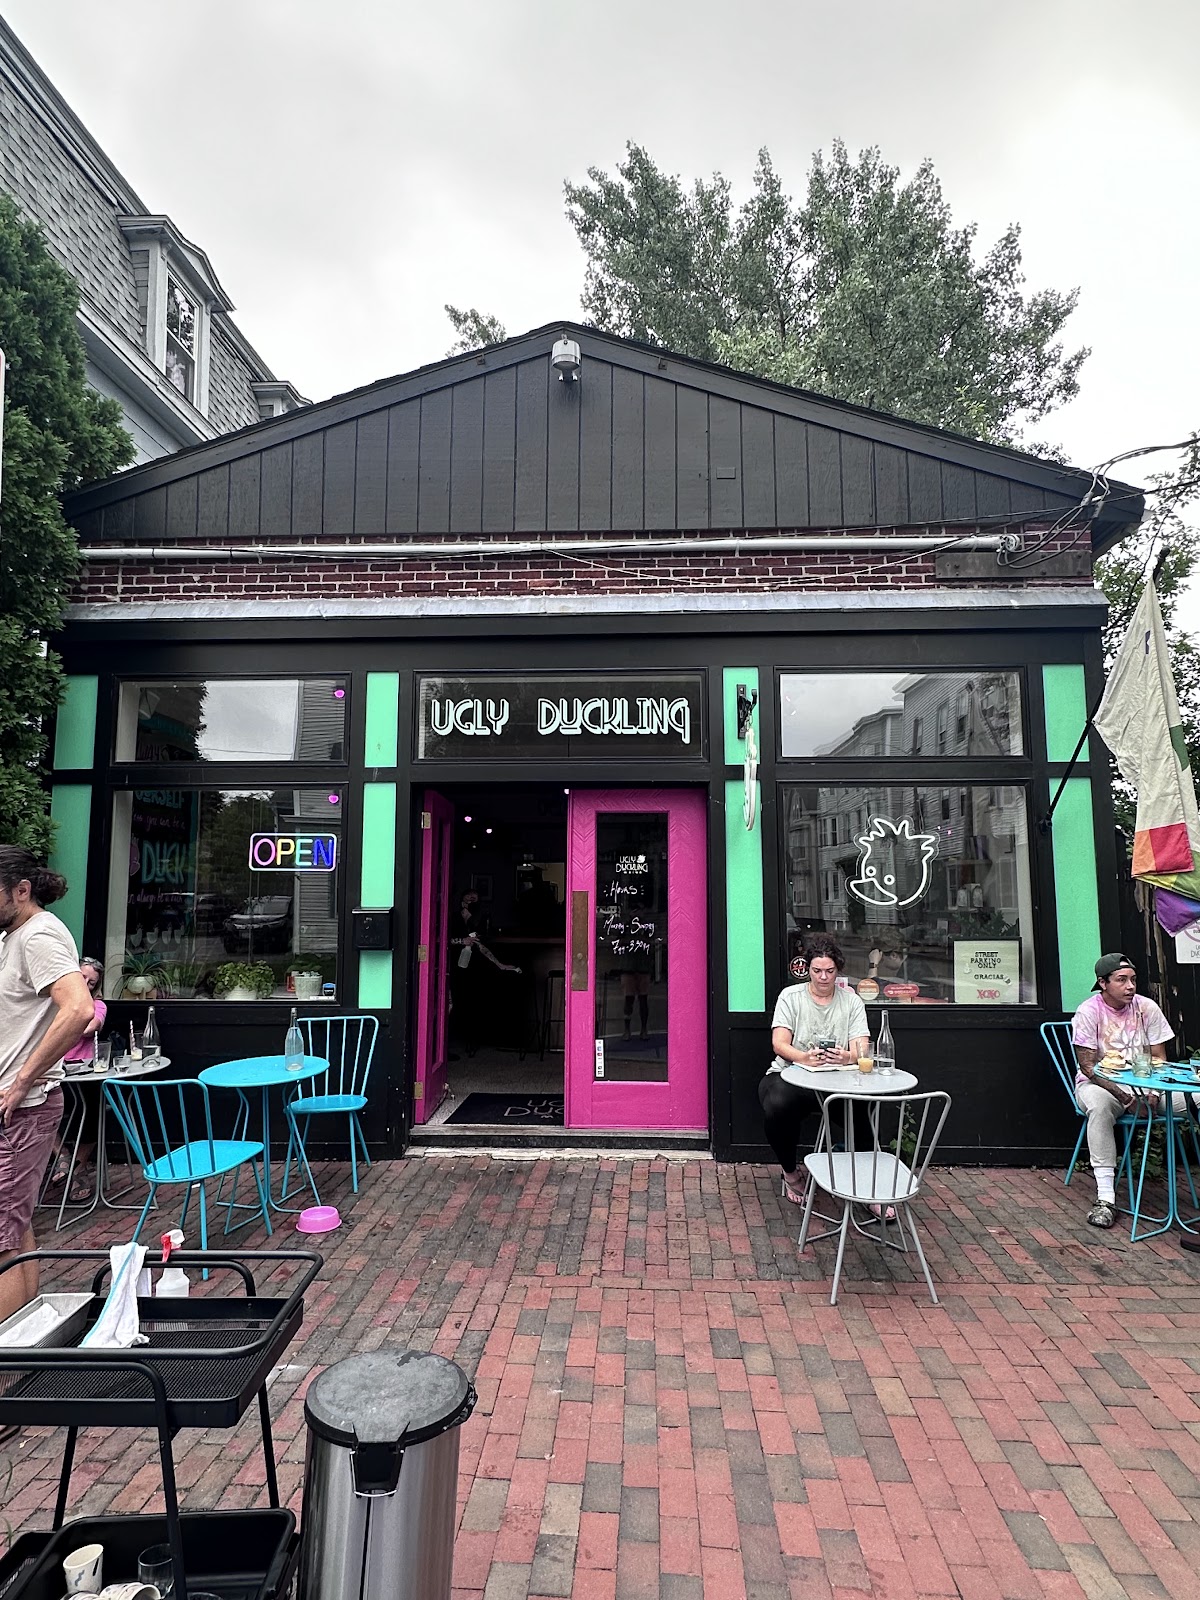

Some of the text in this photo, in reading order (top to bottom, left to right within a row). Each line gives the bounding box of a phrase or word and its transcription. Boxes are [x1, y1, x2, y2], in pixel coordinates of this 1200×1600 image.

[431, 697, 691, 744] UGLY DUCKLING
[141, 839, 187, 885] DUCK
[253, 838, 334, 867] OPEN
[619, 855, 637, 864] UGLY
